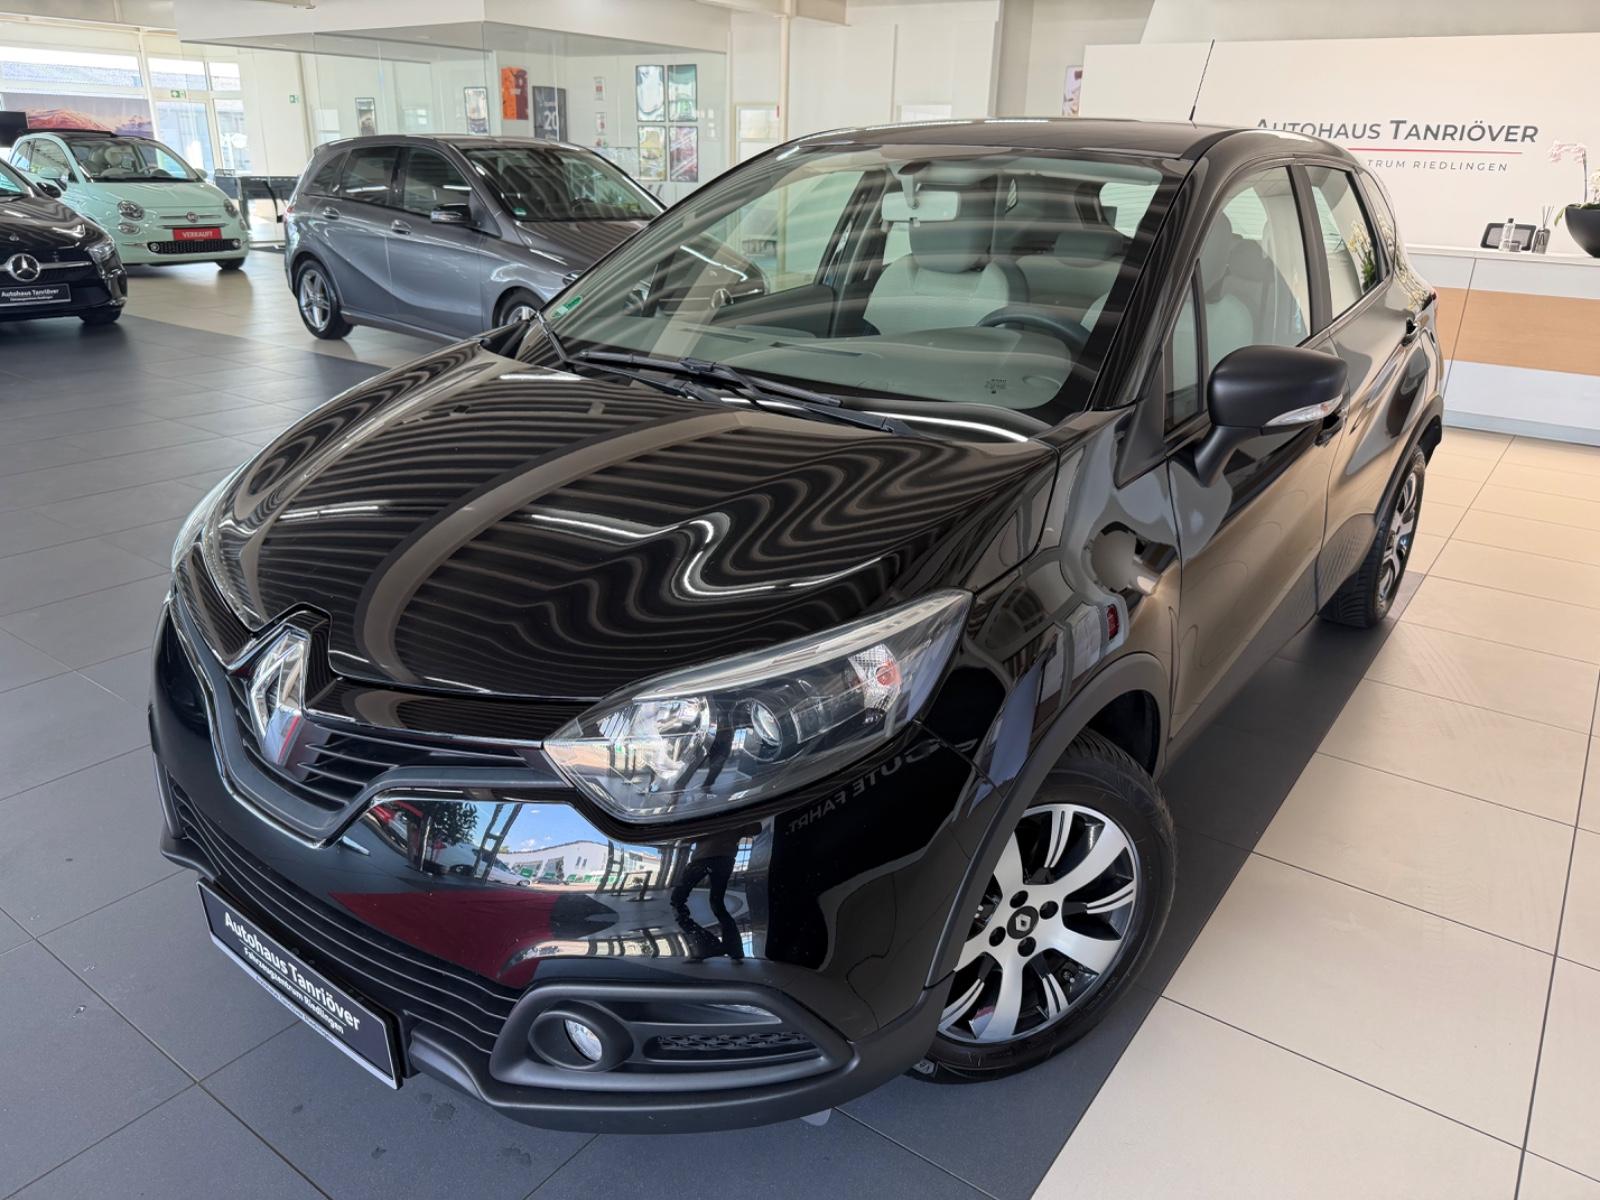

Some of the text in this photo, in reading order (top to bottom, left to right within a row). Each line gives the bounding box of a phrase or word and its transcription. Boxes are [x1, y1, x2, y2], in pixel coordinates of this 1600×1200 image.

[1389, 120, 1539, 143] TANRIÖVER
[1412, 160, 1509, 171] RIEDLINGEN
[225, 912, 288, 975] Autohaus
[288, 962, 360, 1031] Tanriöver
[304, 995, 344, 1034] Riedlingen
